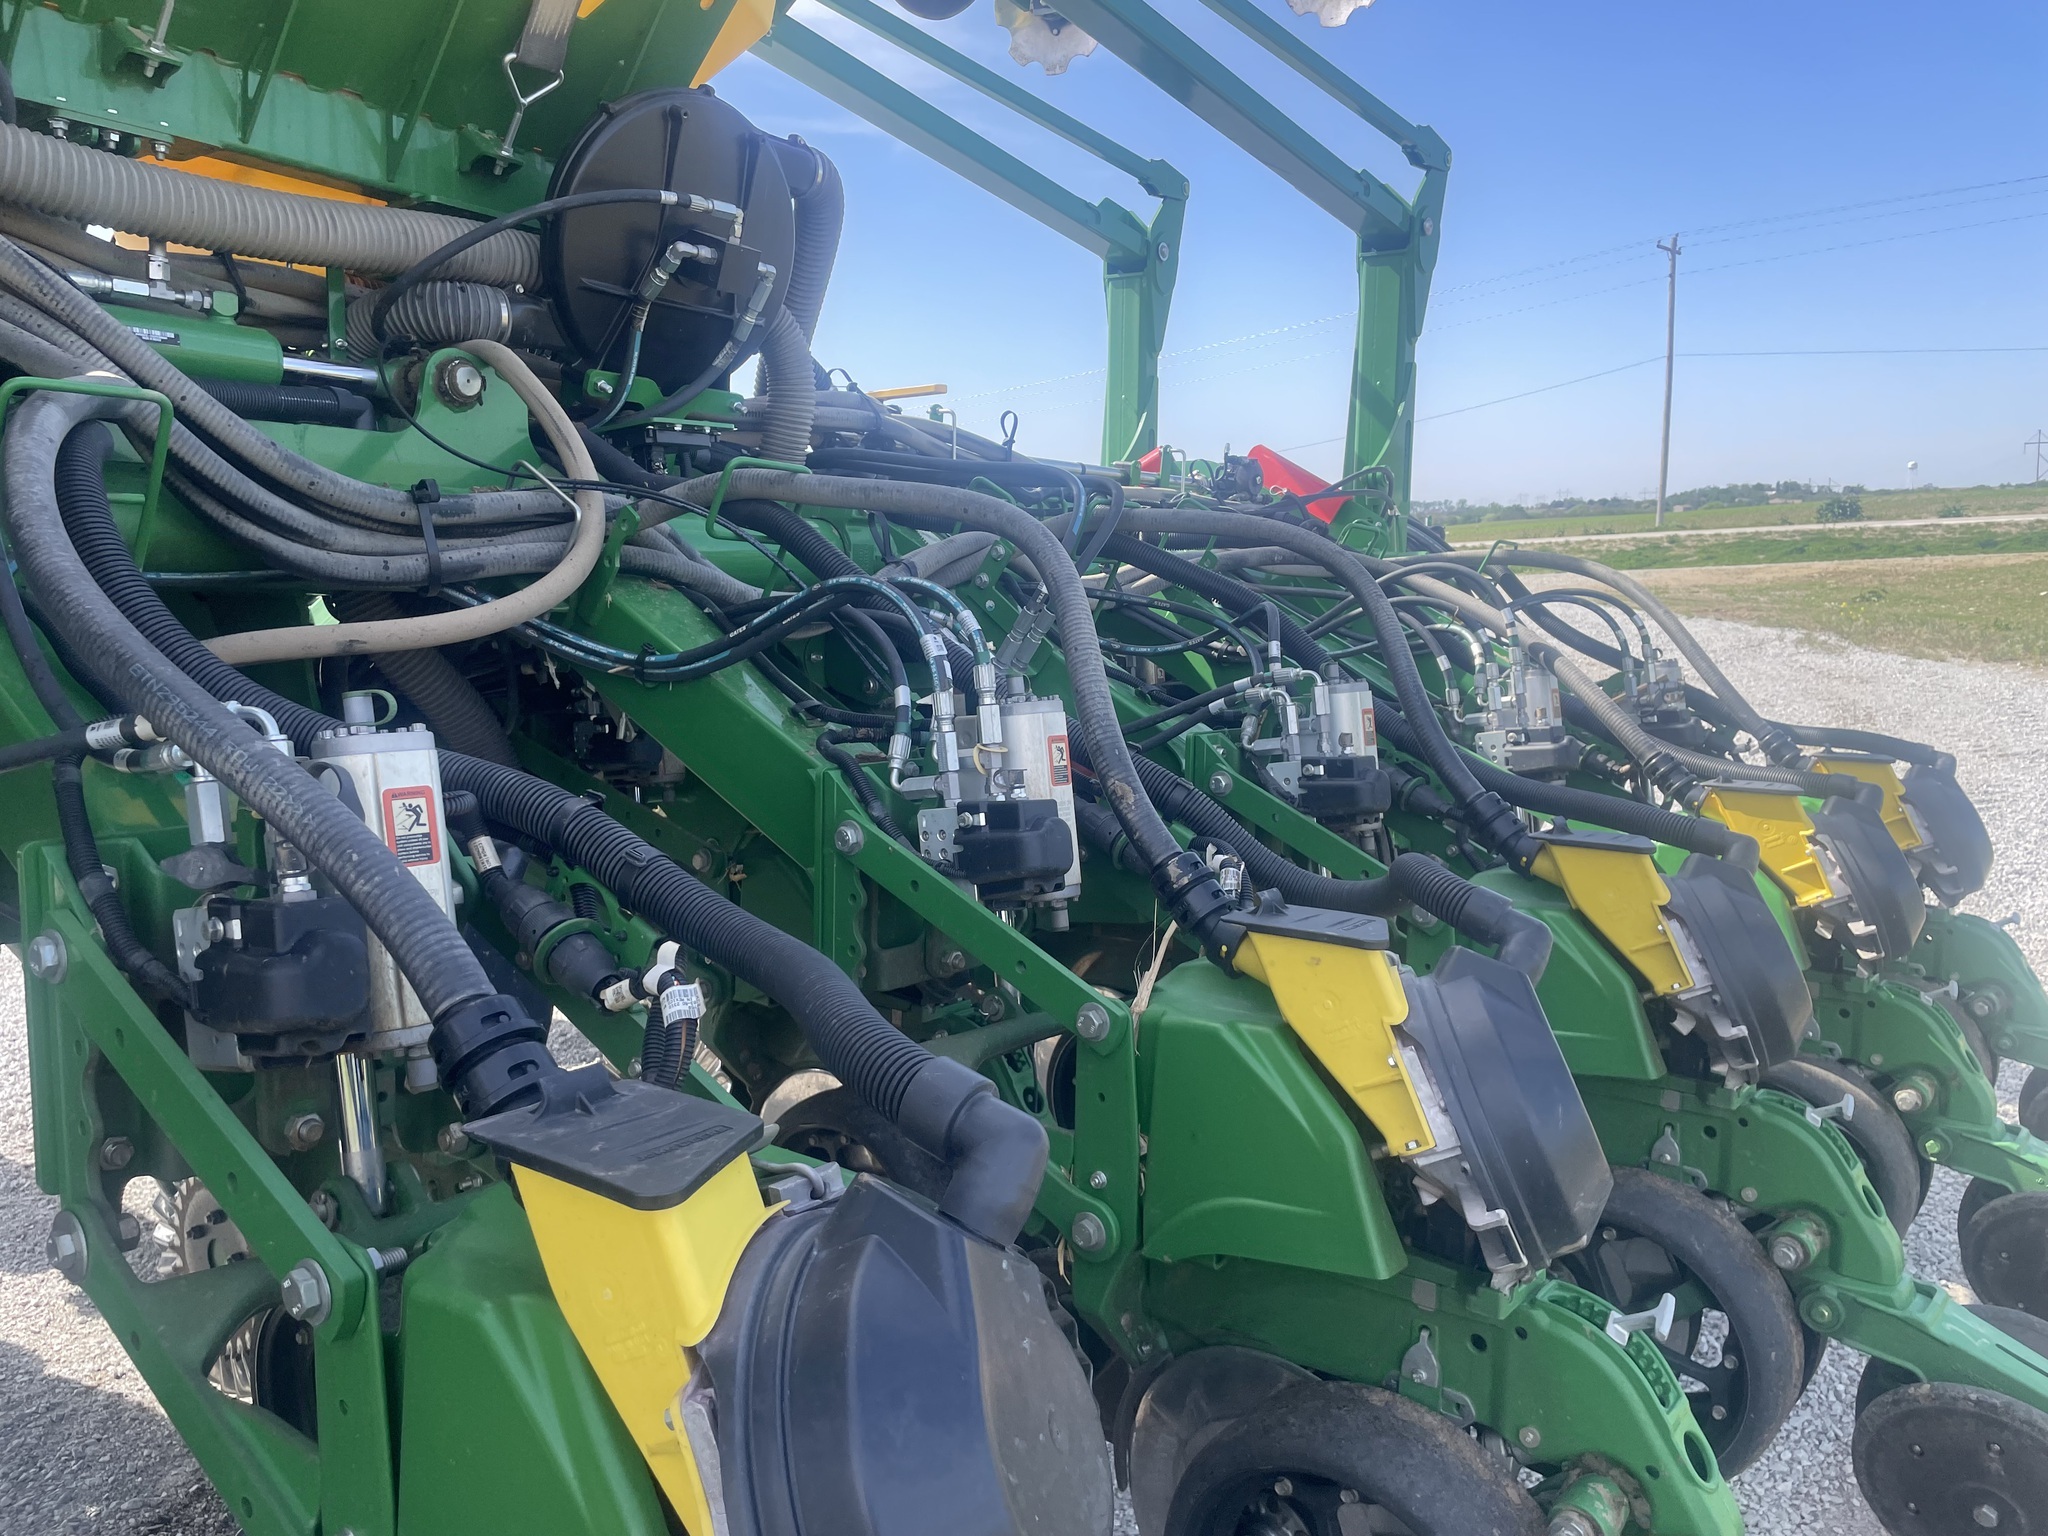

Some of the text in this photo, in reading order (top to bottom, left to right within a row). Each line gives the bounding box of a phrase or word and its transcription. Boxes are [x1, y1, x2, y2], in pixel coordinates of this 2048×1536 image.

[729, 625, 747, 638] GATES
[129, 663, 218, 737] ETN295244
[227, 741, 259, 773] ROW
